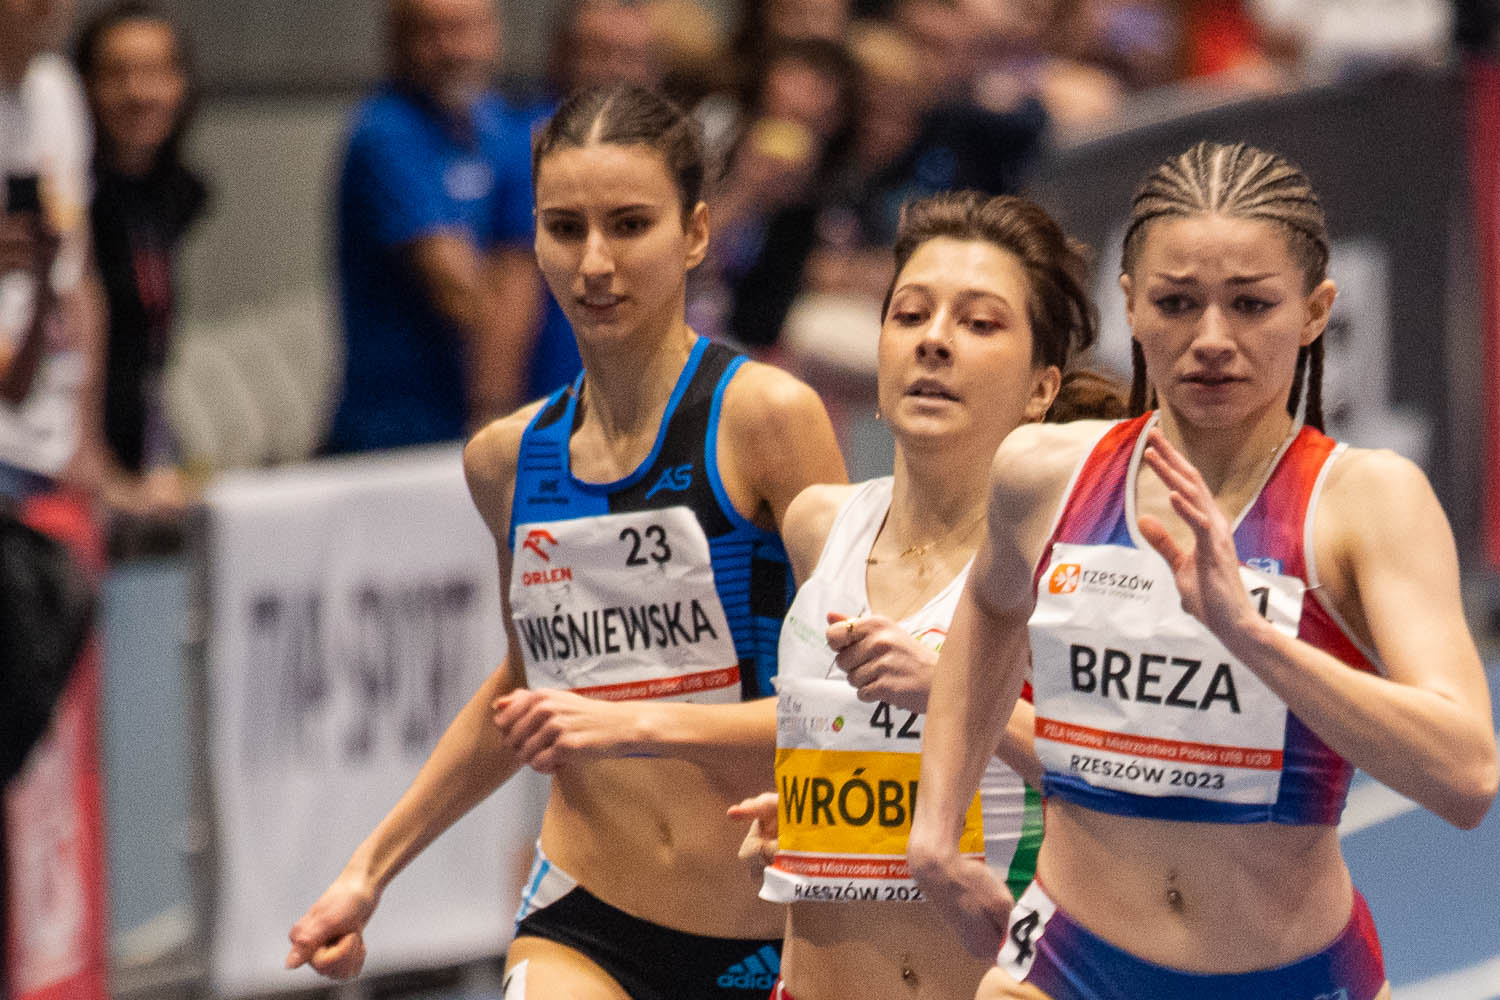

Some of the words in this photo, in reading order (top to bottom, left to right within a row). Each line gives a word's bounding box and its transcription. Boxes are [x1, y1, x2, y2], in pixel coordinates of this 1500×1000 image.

[619, 525, 672, 567] 23
[522, 567, 573, 587] ORLEN
[1081, 567, 1154, 592] rzeszów
[519, 600, 718, 662] WIŚNIEWSKA
[1069, 643, 1242, 714] BREZA
[1070, 754, 1164, 784] RZESZÓW
[1170, 769, 1225, 790] 2023
[884, 885, 923, 901] 202
[716, 971, 778, 991] adid
